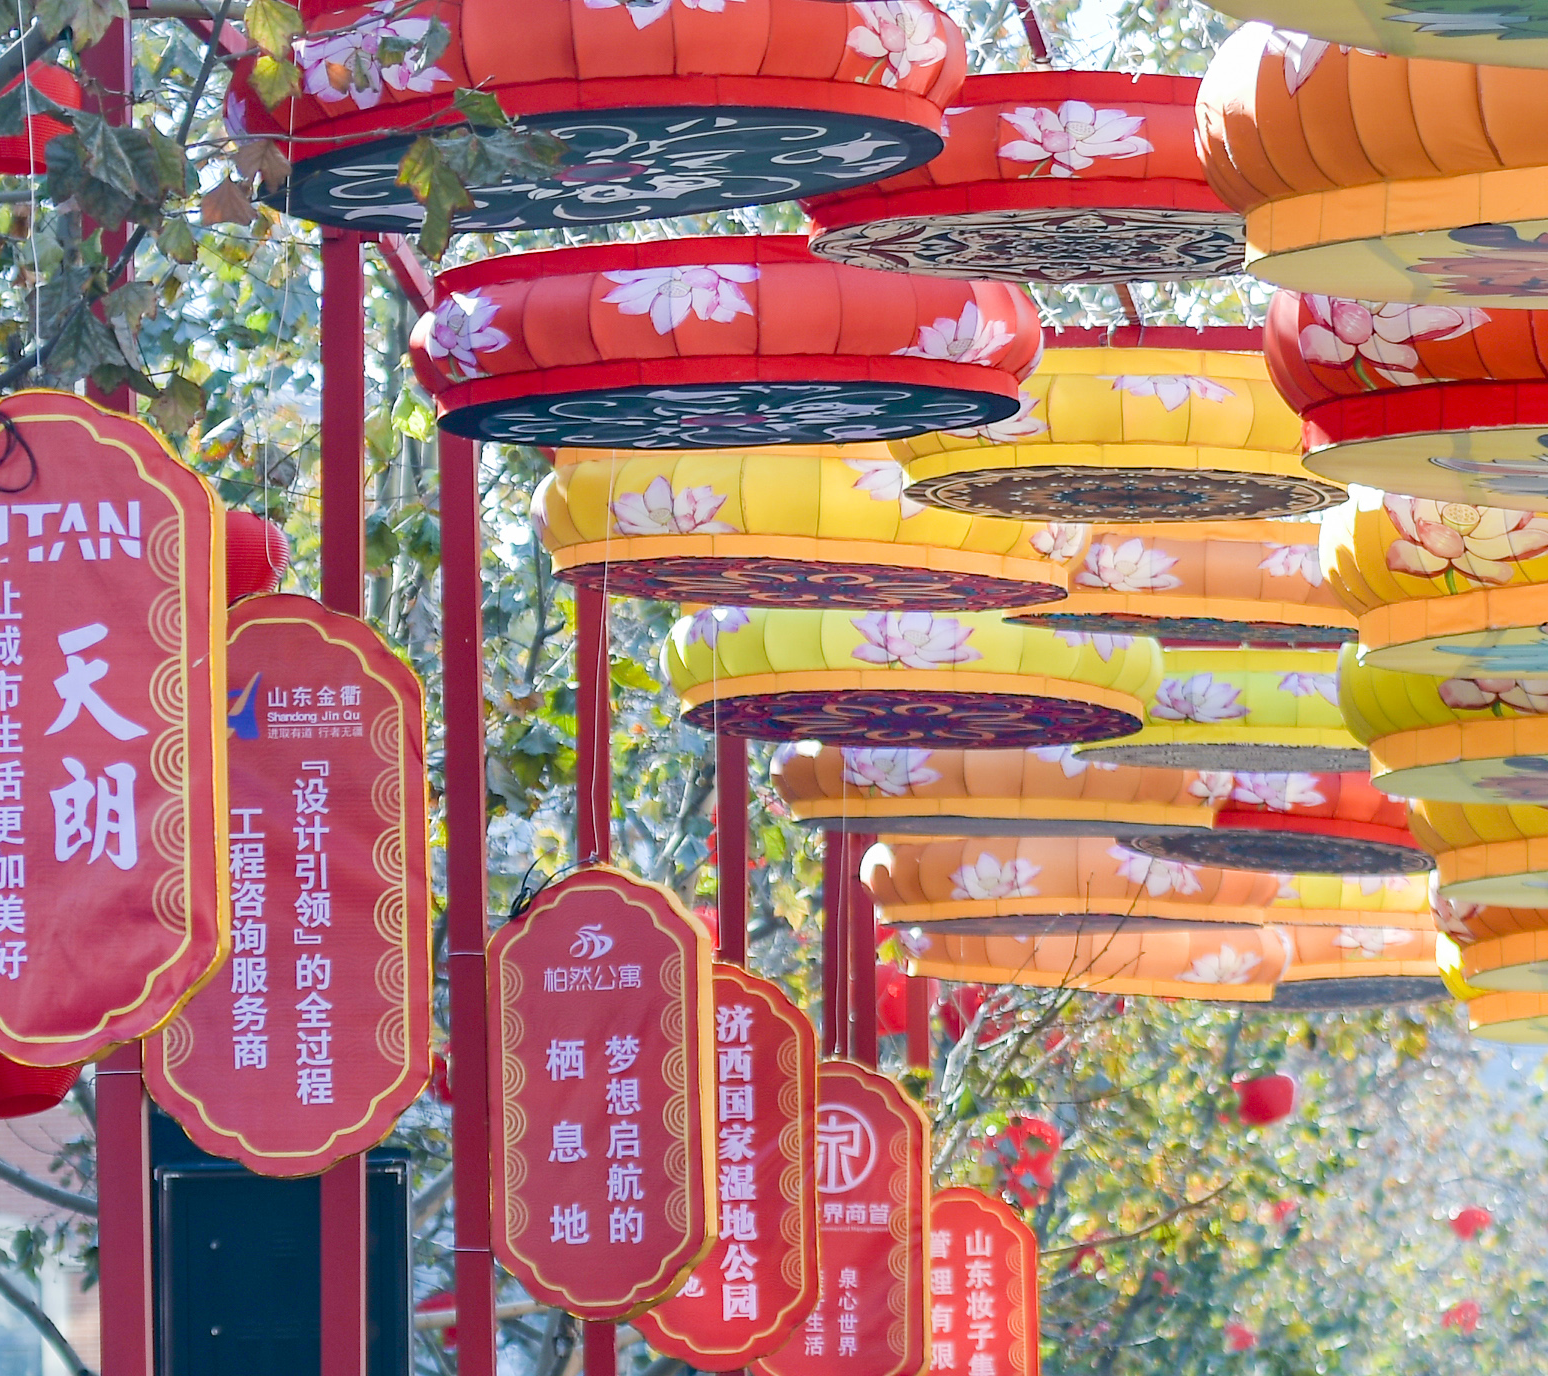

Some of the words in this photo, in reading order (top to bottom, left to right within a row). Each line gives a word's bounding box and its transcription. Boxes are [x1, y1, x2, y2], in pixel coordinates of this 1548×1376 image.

[43, 617, 153, 871] 天朗
[266, 710, 318, 724] Shandong
[321, 710, 340, 722] Jin
[343, 710, 361, 721] Qu
[225, 803, 269, 1070] 工程咨询服务商
[291, 760, 334, 1106] 『设计引领』的全过程
[543, 963, 642, 993] 柏然公寓
[545, 1039, 591, 1245] 栖息地
[604, 1034, 645, 1244] 梦想启航的
[713, 1004, 759, 1322] 济西国家湿地公园
[817, 1201, 891, 1226] 界商管
[804, 1270, 826, 1357] 生活
[837, 1267, 859, 1357] 泉心世界
